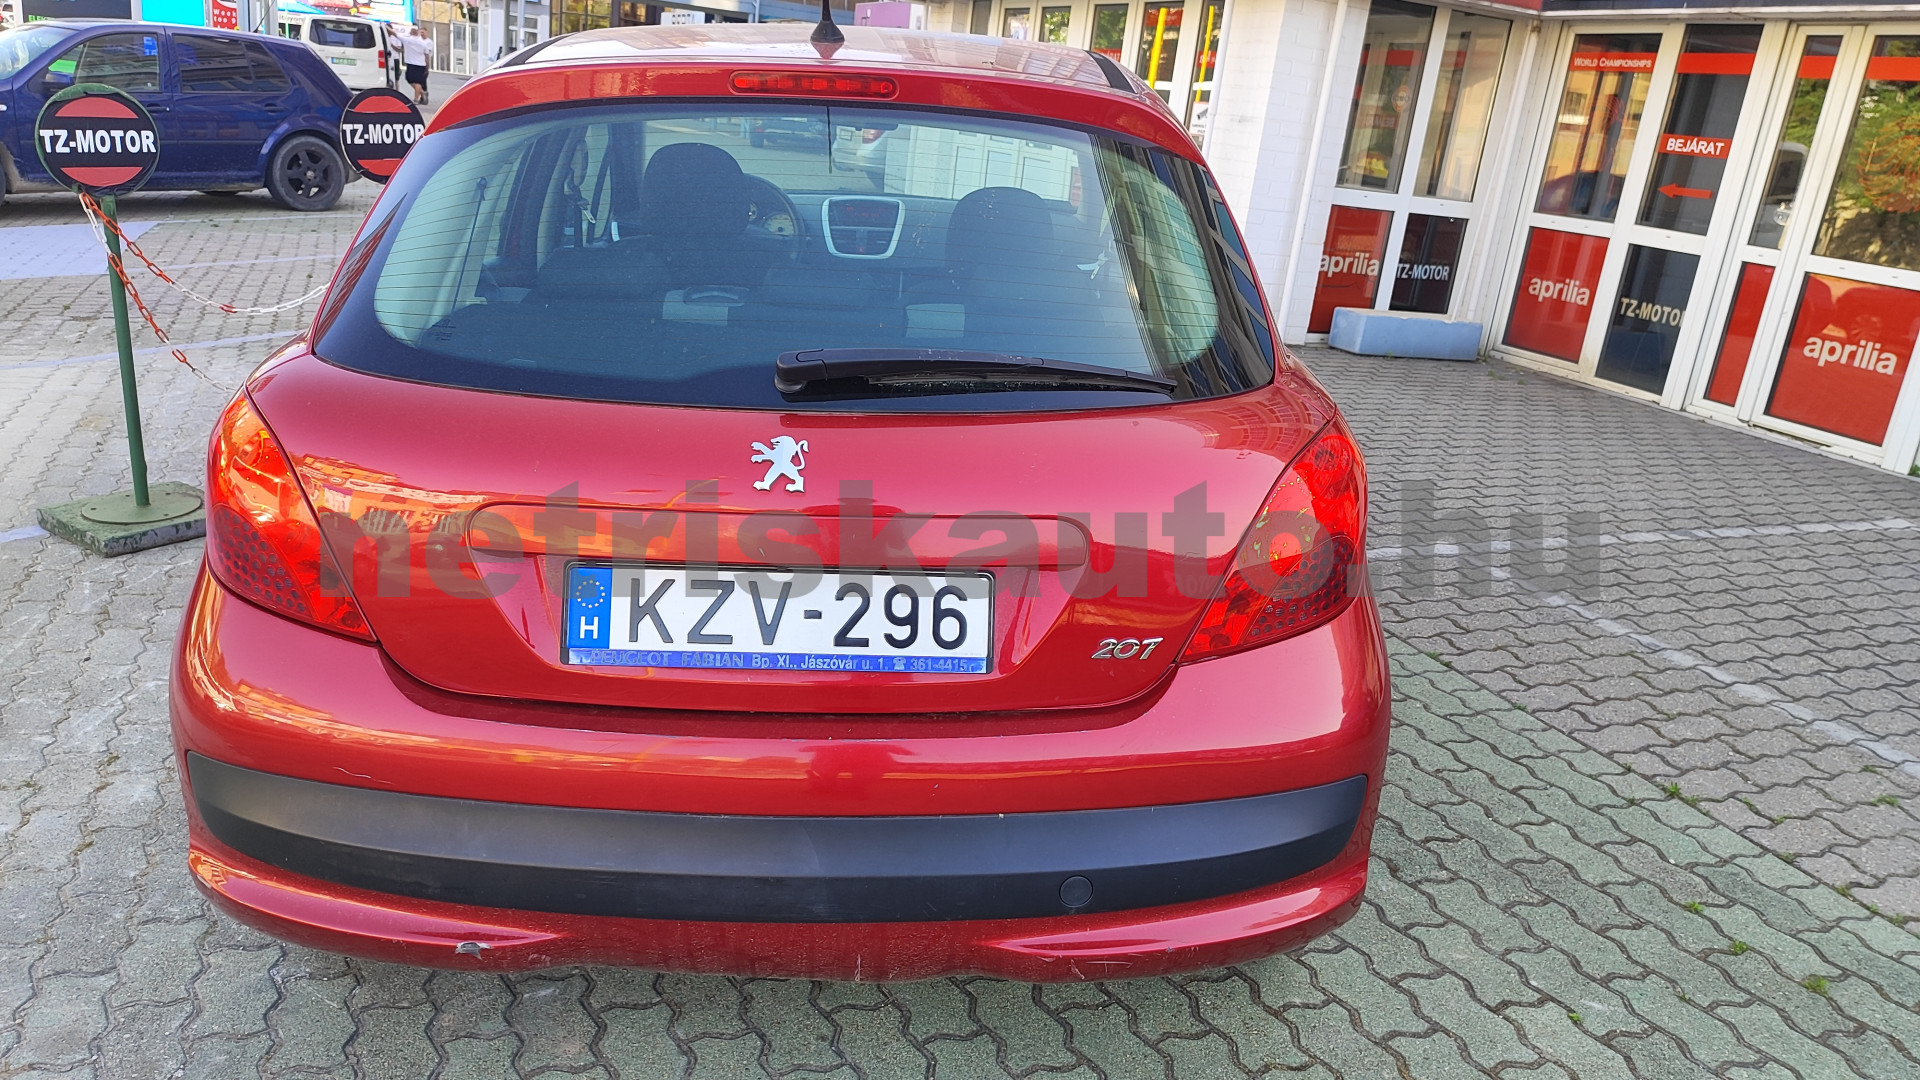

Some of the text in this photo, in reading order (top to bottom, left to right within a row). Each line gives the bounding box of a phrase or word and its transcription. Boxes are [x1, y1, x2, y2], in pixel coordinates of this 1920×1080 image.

[39, 129, 157, 154] TZ-MOTOR
[1666, 137, 1725, 156] BEJÁRAT
[1320, 252, 1380, 278] aprilia
[1397, 263, 1450, 281] TZ-MOTOR
[1528, 277, 1590, 306] aprilia
[1803, 336, 1898, 376] aprilia
[628, 577, 968, 650] KZV-296
[579, 616, 599, 640] H
[591, 650, 672, 666] PEUGEOT
[751, 653, 773, 668] Bp.
[801, 654, 858, 670] Jászóvár
[1091, 637, 1164, 660] 207
